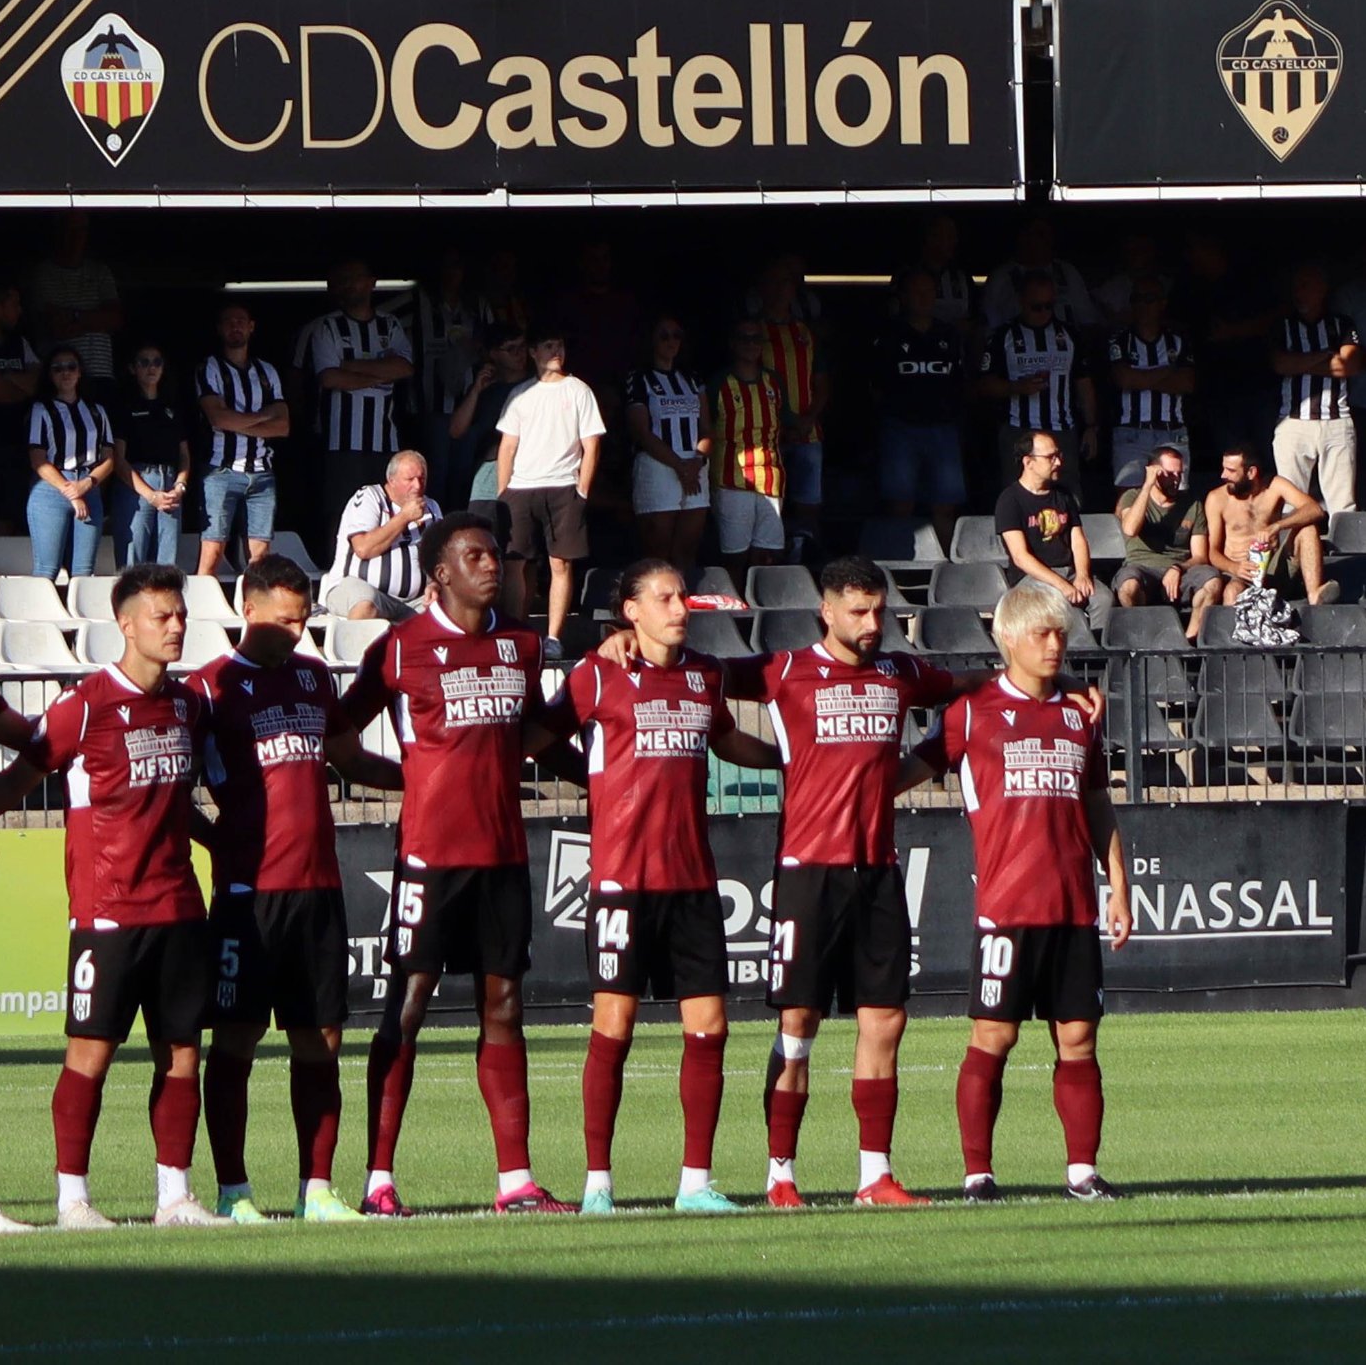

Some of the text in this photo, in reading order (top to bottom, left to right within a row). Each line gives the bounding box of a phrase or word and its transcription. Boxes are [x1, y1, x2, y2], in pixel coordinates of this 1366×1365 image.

[1251, 56, 1327, 70] CASTELLÓN
[816, 713, 898, 737] MÉRIDA
[1133, 857, 1161, 875] DE
[594, 907, 630, 950] 14
[74, 949, 95, 990] 6
[219, 937, 240, 976] 5
[981, 933, 1013, 976] 10
